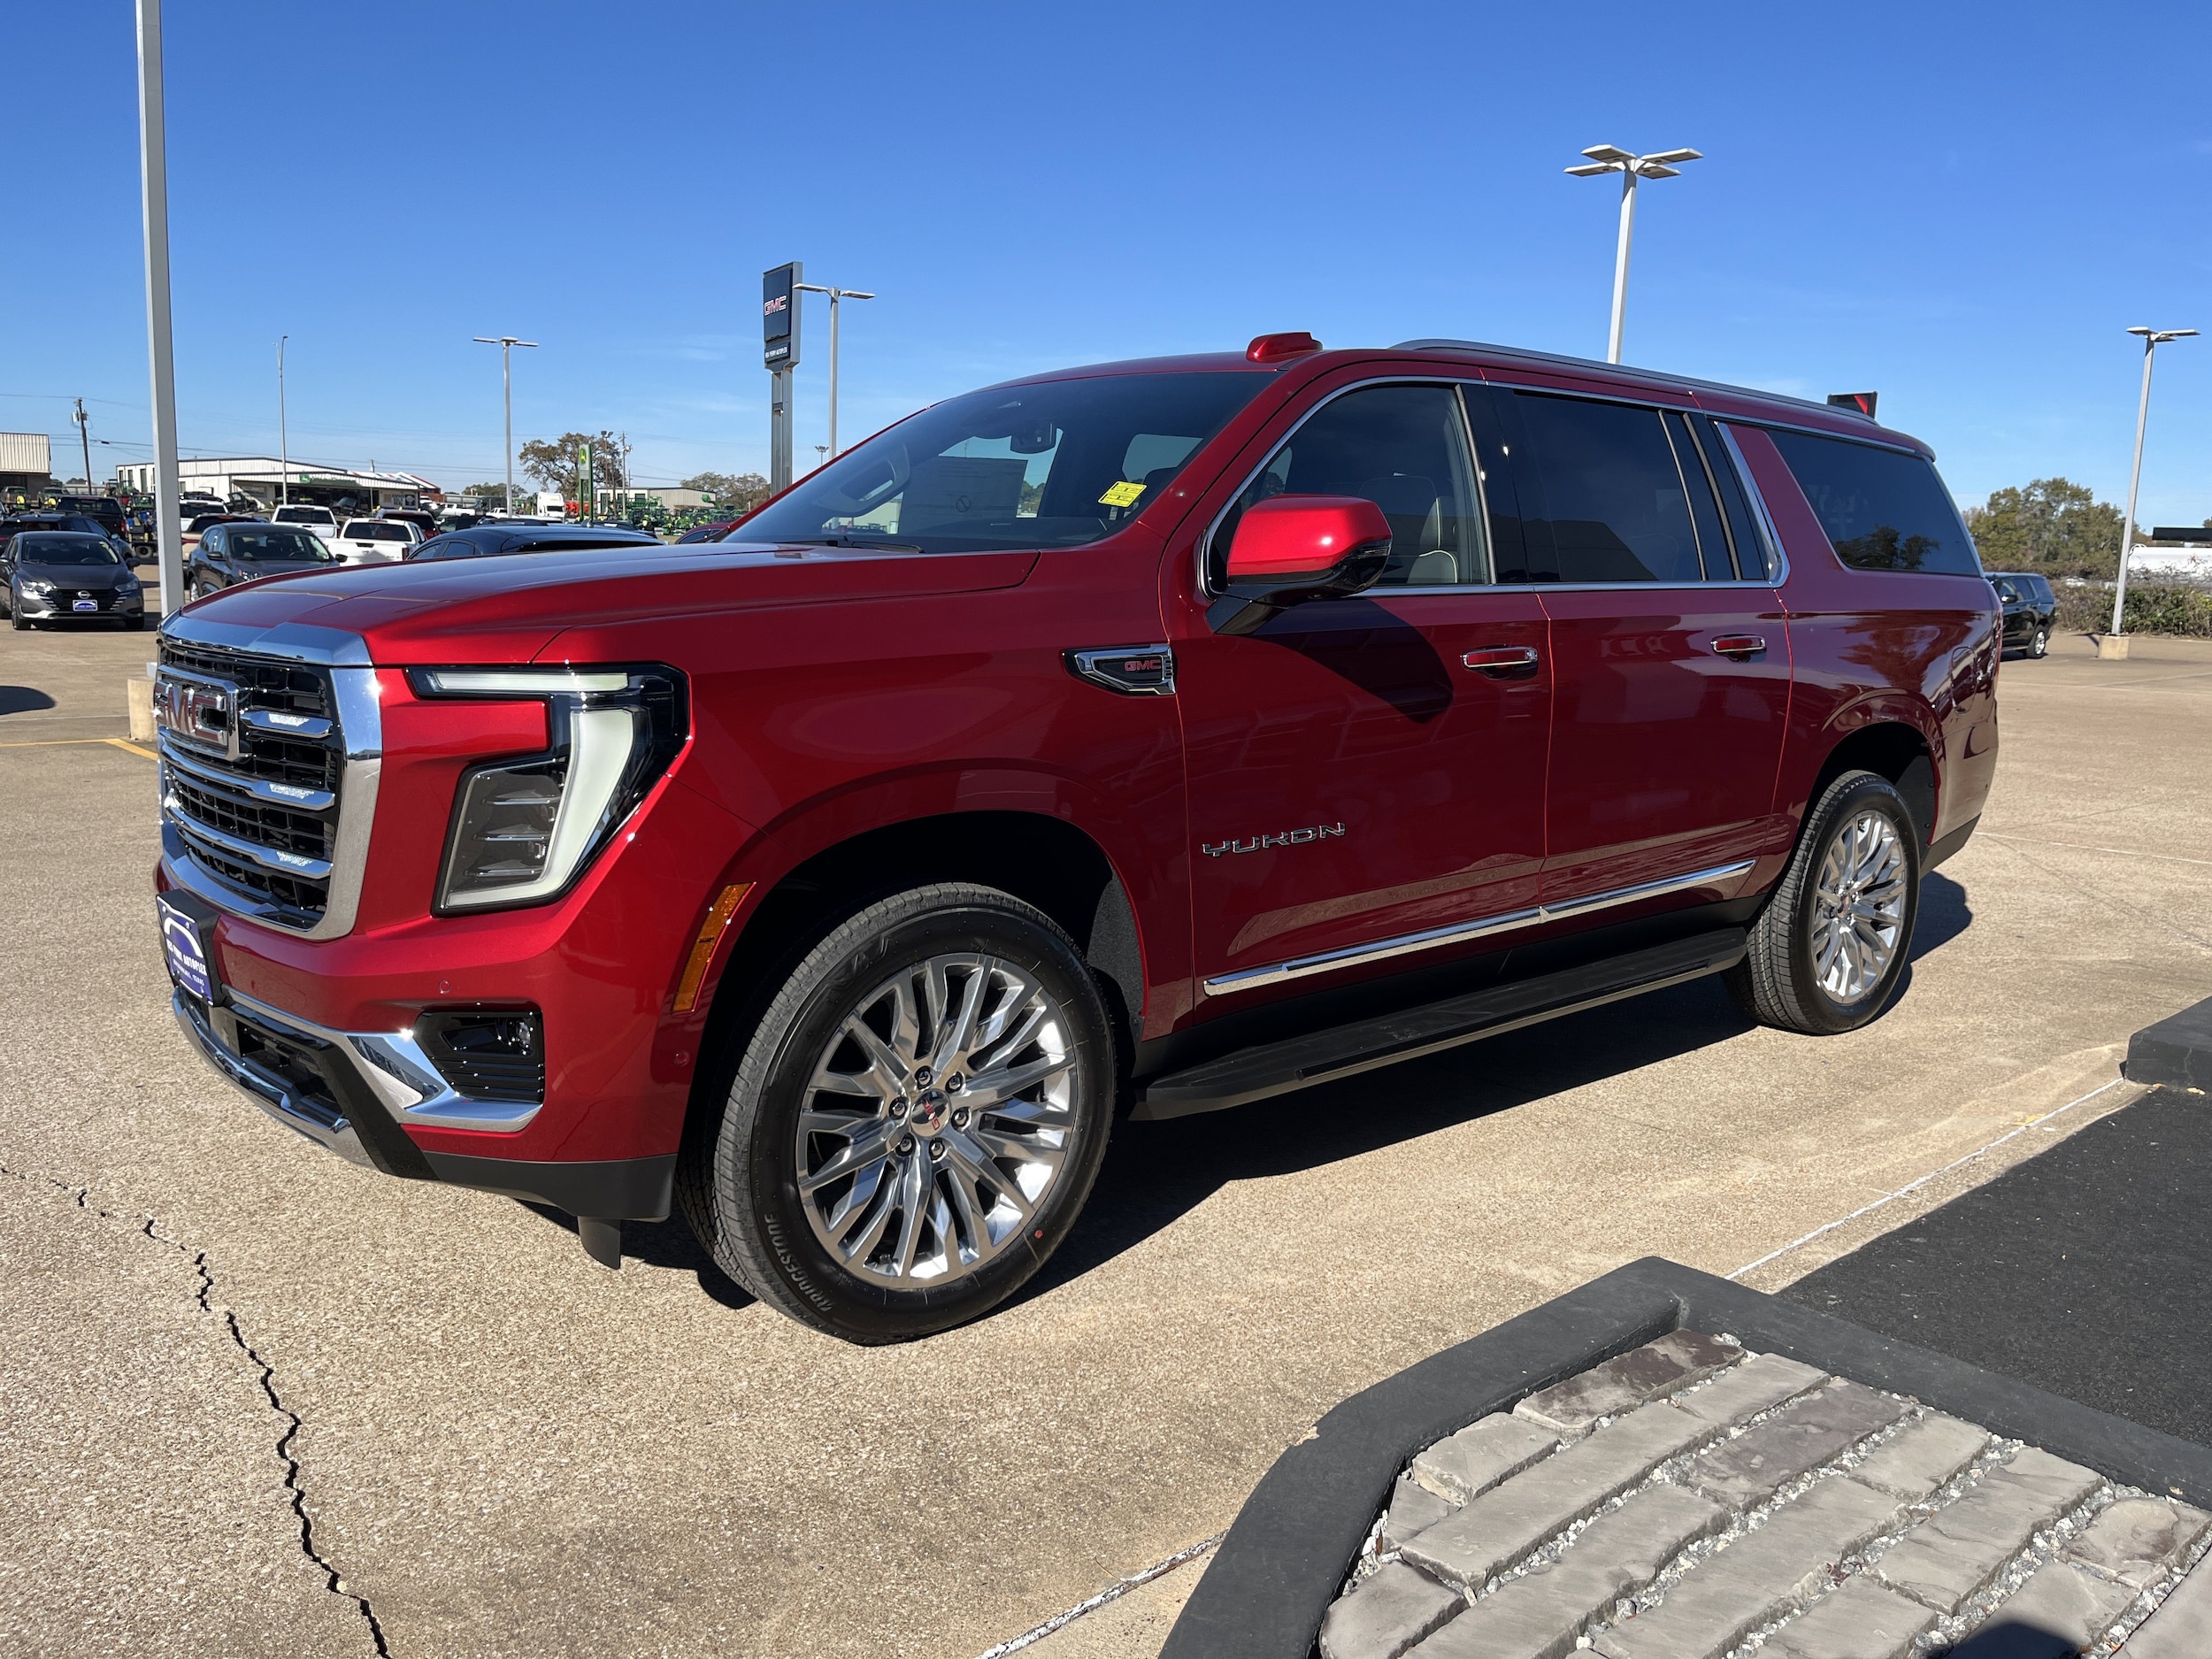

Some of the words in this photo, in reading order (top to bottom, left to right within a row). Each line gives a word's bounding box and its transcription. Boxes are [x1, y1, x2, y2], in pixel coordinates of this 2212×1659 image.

[764, 295, 787, 316] GMC
[1125, 659, 1161, 672] GMC
[153, 681, 228, 746] GMC
[1202, 822, 1345, 856] YUKON
[921, 1097, 941, 1131] GMC
[764, 1213, 833, 1312] BRIDGESTONE
